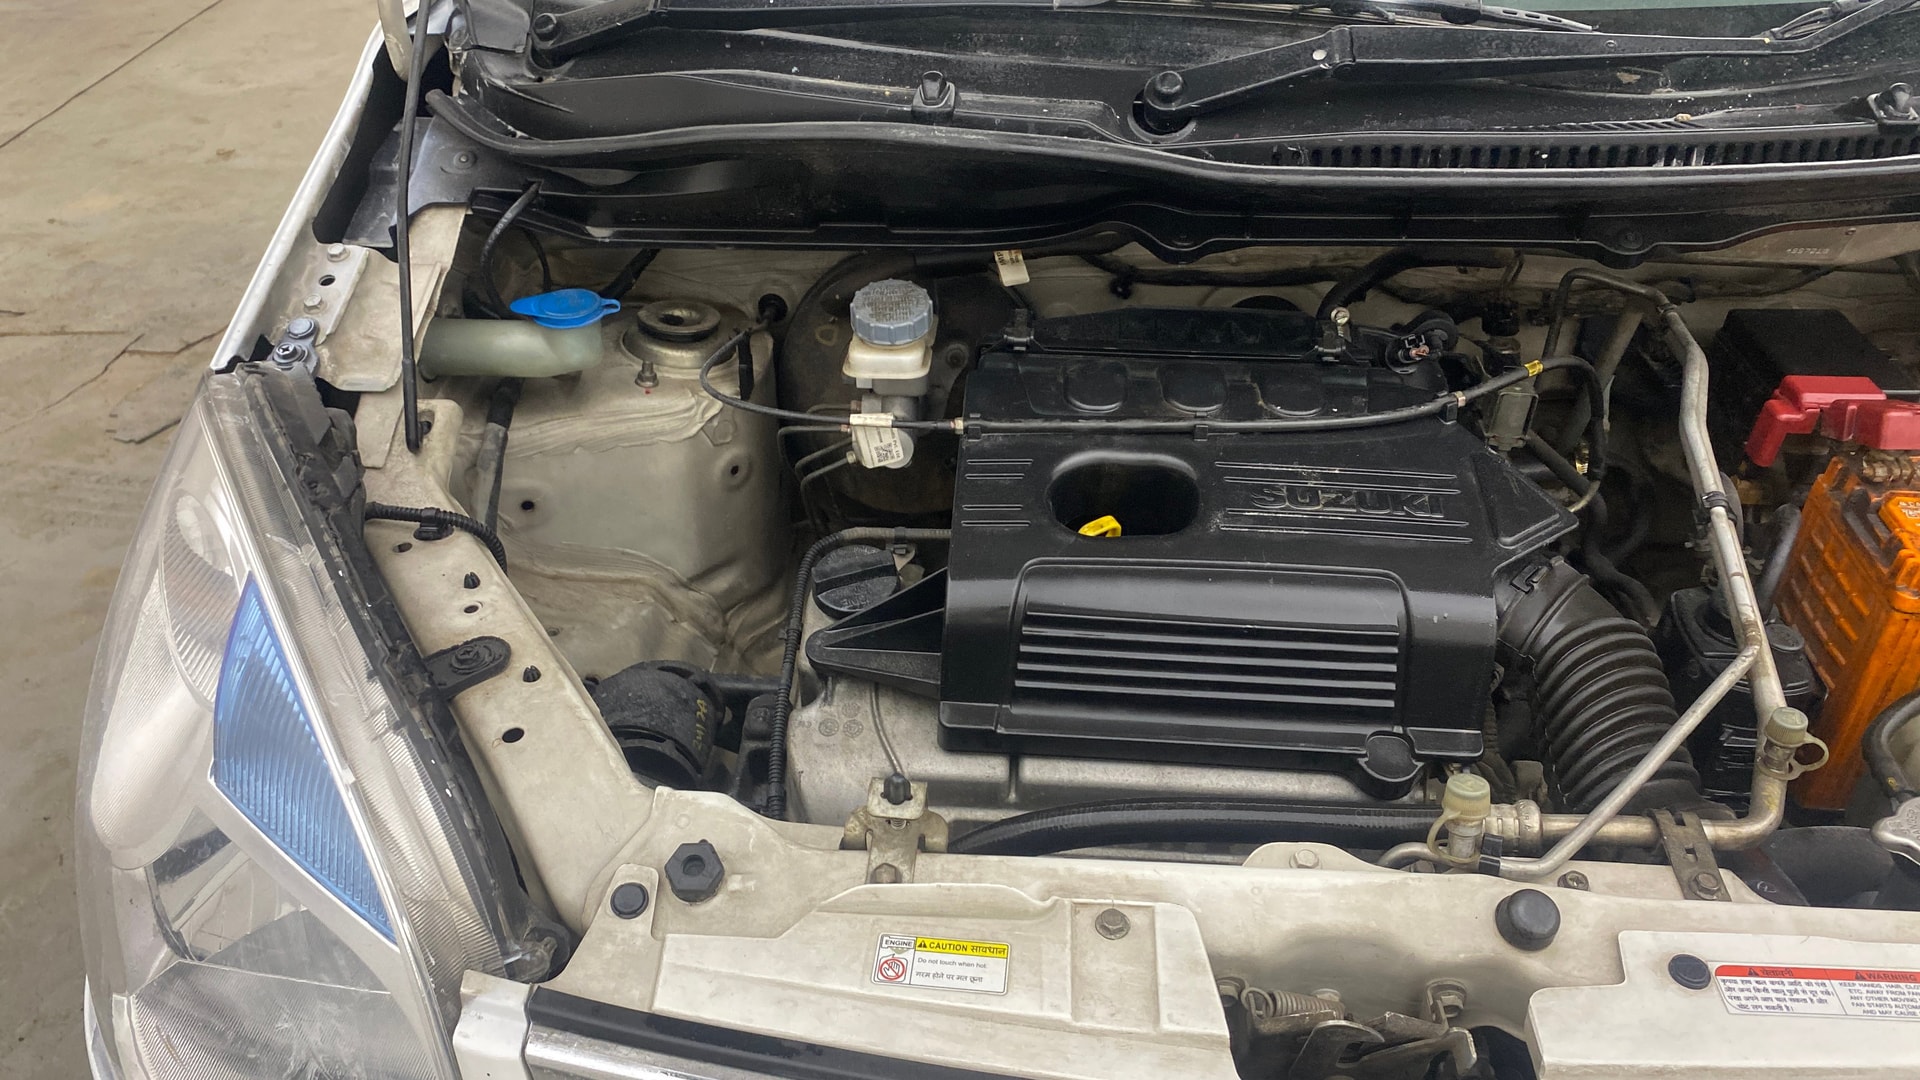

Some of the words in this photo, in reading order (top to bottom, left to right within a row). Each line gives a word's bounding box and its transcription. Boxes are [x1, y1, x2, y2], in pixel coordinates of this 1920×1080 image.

[1251, 484, 1445, 518] SUZUKI
[929, 941, 968, 952] CAUTION
[971, 945, 1006, 955] सावधान
[932, 971, 944, 979] होने
[1760, 968, 1794, 977] चेतावनी
[1866, 972, 1917, 981] WARNING
